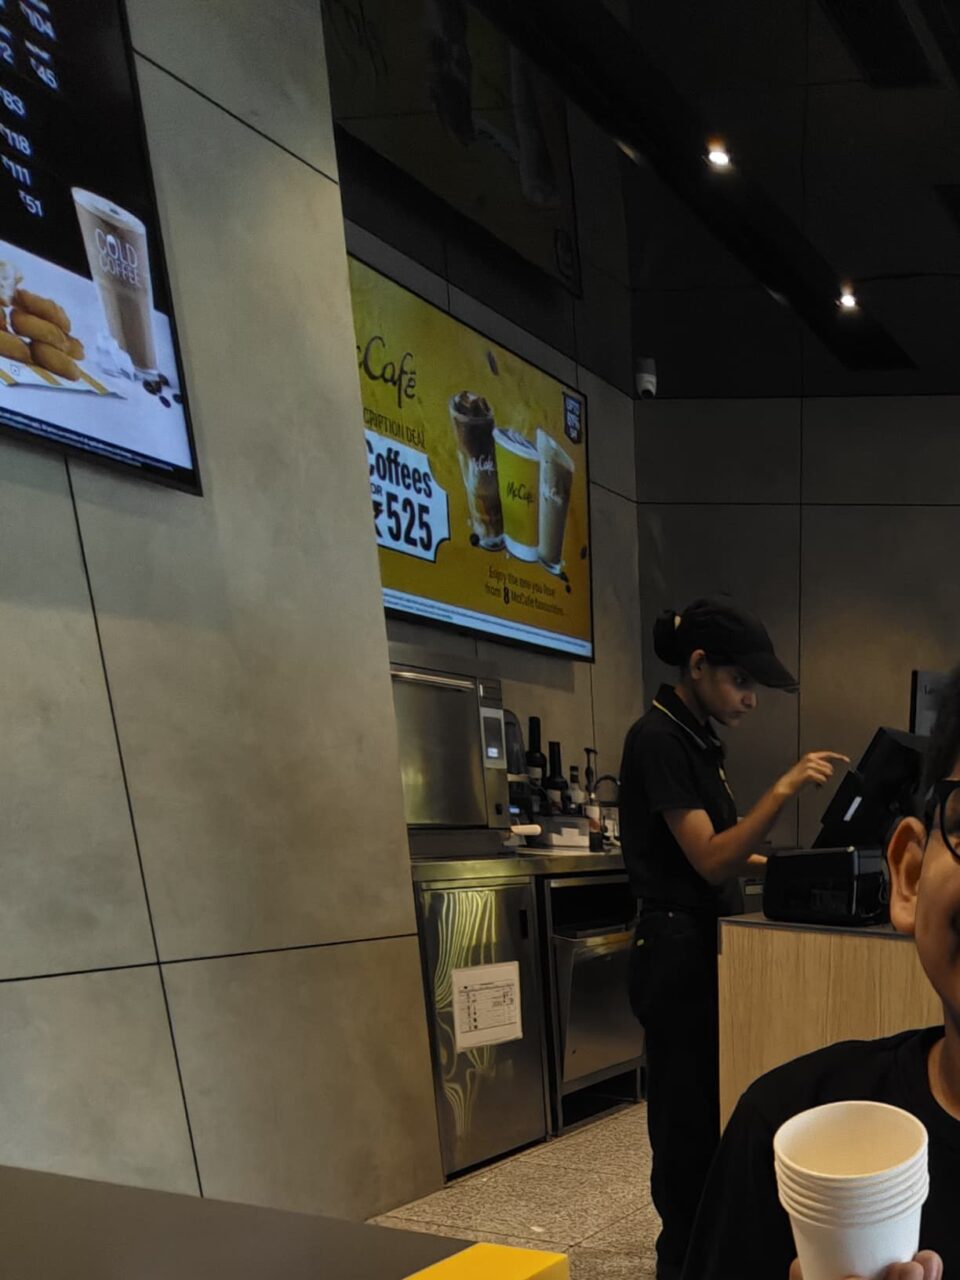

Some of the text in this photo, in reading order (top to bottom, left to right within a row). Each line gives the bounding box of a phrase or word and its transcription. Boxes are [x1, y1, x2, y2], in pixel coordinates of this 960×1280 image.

[95, 228, 137, 268] COLD
[100, 256, 142, 288] COFFEE
[503, 586, 510, 605] 8
